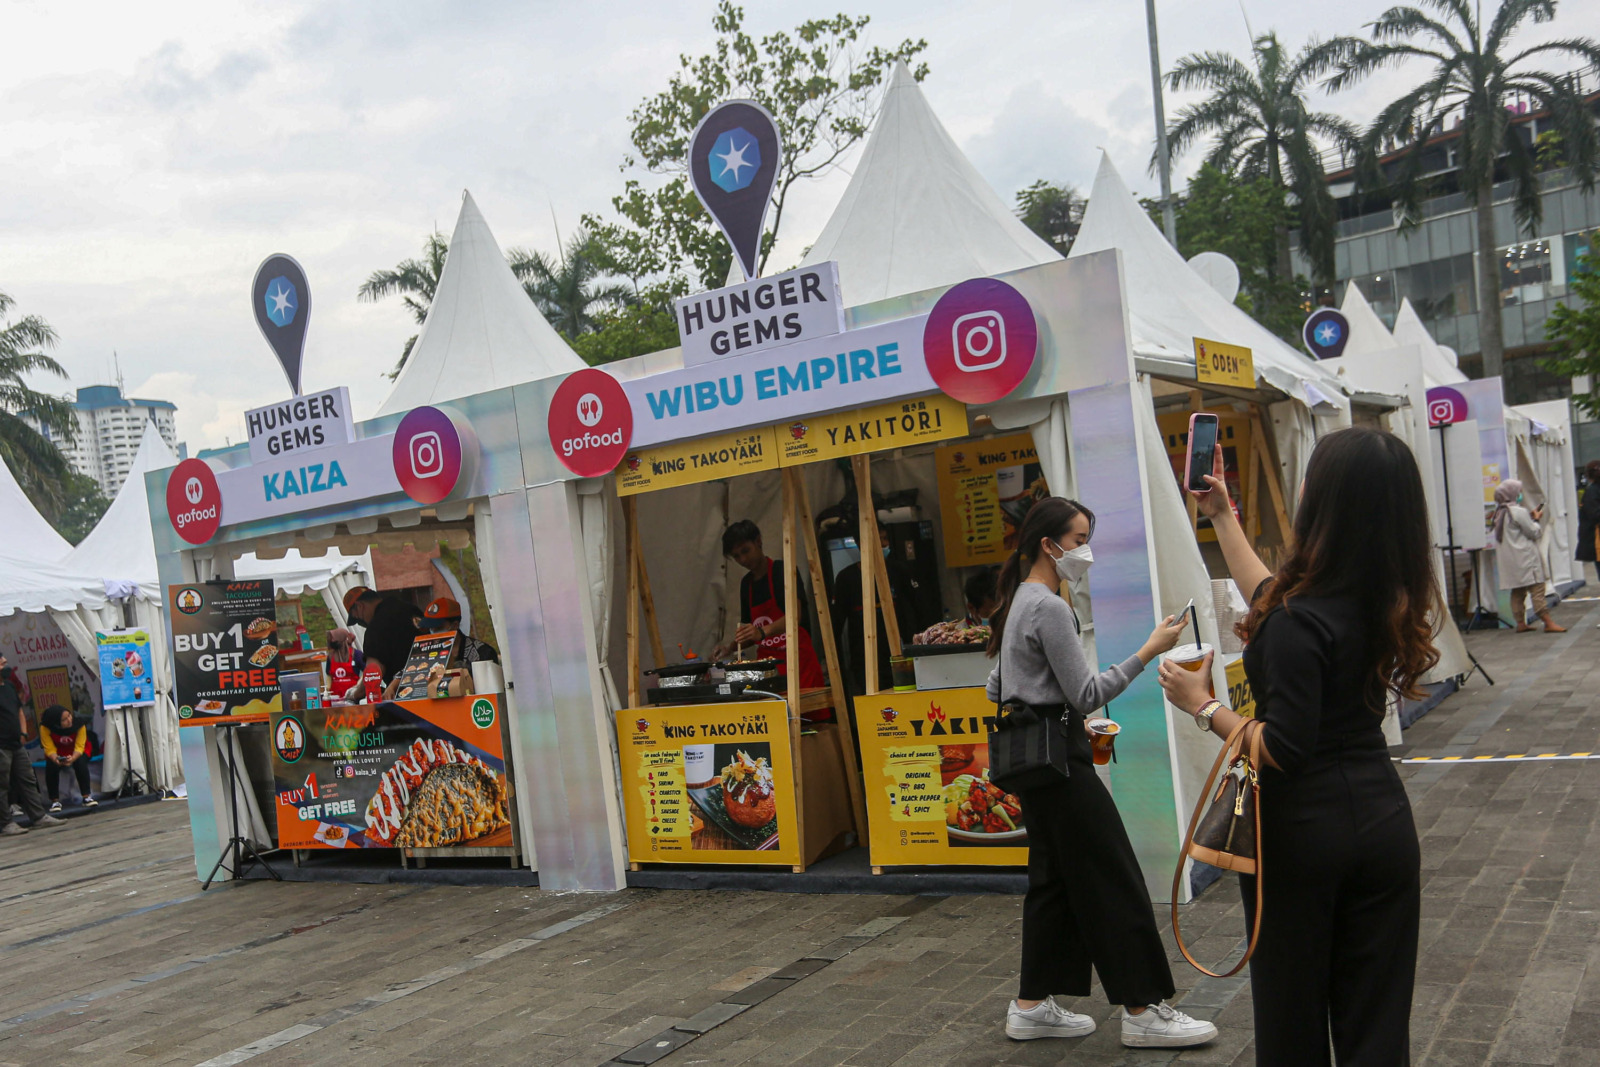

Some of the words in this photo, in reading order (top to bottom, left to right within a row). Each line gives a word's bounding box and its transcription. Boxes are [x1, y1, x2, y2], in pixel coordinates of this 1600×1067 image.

[682, 272, 827, 335] HUNGER
[710, 312, 802, 355] GEMS
[1212, 353, 1239, 373] ODEN
[645, 374, 744, 420] WIBU
[755, 342, 902, 400] EMPIRE
[248, 394, 339, 438] HUNGER
[826, 408, 942, 446] YAKITORI
[267, 424, 325, 455] GEMS
[562, 427, 623, 457] gofood
[652, 457, 686, 475] KING
[690, 443, 763, 468] TAKOYAKI
[978, 452, 1006, 465] KING
[262, 460, 348, 502] KAIZA
[176, 504, 217, 528] gofood
[225, 591, 262, 599] TACOSUSHI
[226, 582, 261, 592] KAIZA
[174, 631, 225, 652] BUY
[227, 622, 244, 649] 1
[198, 652, 243, 672] GET
[32, 672, 67, 690] SUPPORT
[218, 668, 277, 689] FREE
[197, 688, 245, 697] OKONOMIYAKI
[324, 711, 375, 731] KAIZA
[664, 725, 696, 739] KING
[700, 722, 769, 737] TAKOYAKI
[910, 716, 997, 737] YAKIT
[322, 732, 385, 750] TACOSUSHI
[355, 768, 377, 776] kaiza_id
[280, 787, 306, 805] BUY
[304, 772, 320, 799] 1
[298, 804, 322, 821] GET
[324, 799, 357, 818] FREE
